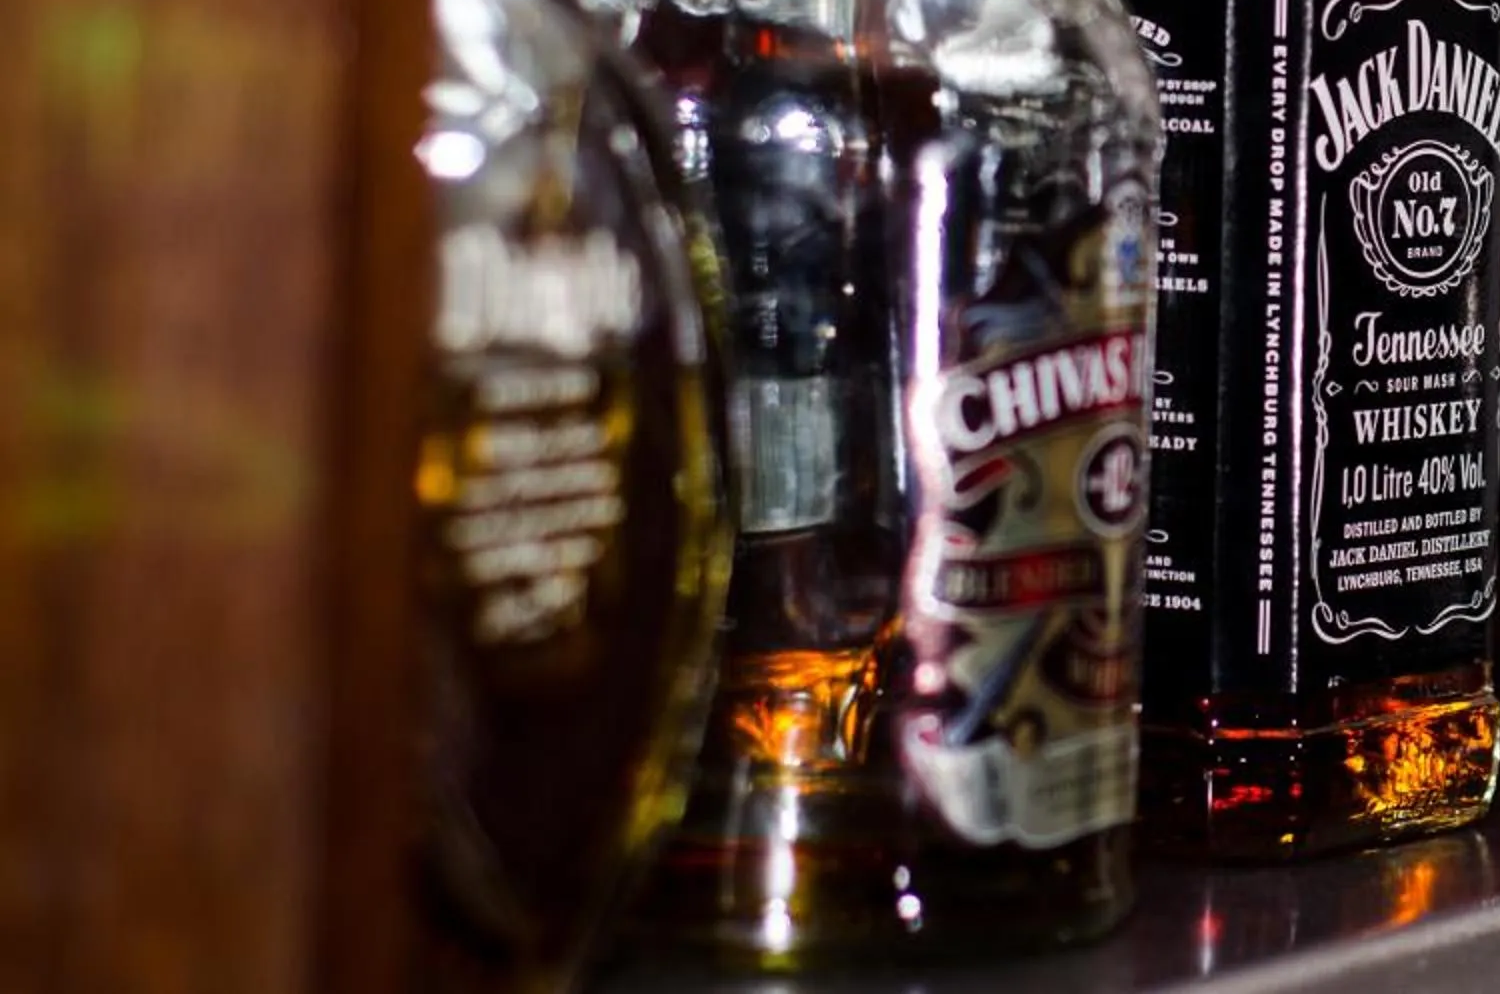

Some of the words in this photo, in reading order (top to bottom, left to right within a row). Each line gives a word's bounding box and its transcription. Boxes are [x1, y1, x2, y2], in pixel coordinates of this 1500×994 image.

[1271, 44, 1288, 123] EVERY
[1310, 45, 1405, 173] JACK
[1269, 127, 1286, 192] DROP
[1407, 171, 1443, 193] Old
[1267, 198, 1284, 266] MADE
[1391, 197, 1458, 239] No.7
[1407, 245, 1443, 259] BRAND
[1266, 271, 1282, 297] IN
[1353, 311, 1485, 367] Tennessee
[940, 334, 1128, 452] CHIVAS
[1262, 303, 1282, 448] LYNCHBURG
[1386, 377, 1419, 394] SOUR
[1423, 373, 1457, 390] MASH
[1353, 397, 1483, 445] WHISKEY
[1371, 463, 1414, 500] Litre
[1417, 455, 1456, 495] 40%
[1459, 451, 1488, 490] Vol.
[1258, 453, 1278, 593] TENNESSEE
[1343, 517, 1399, 540] DISTILLED
[1400, 515, 1424, 533] AND
[1425, 508, 1467, 530] BOTTLED
[1469, 507, 1483, 523] BY
[1329, 547, 1367, 569] JACK
[1369, 540, 1420, 563] DANIEL
[1421, 529, 1491, 556] DISTILLERY
[1337, 568, 1403, 593] LYNCHBURG,
[1405, 559, 1463, 583] TENNESSEE,
[1465, 557, 1484, 573] USA
[1164, 595, 1202, 611] 1904
